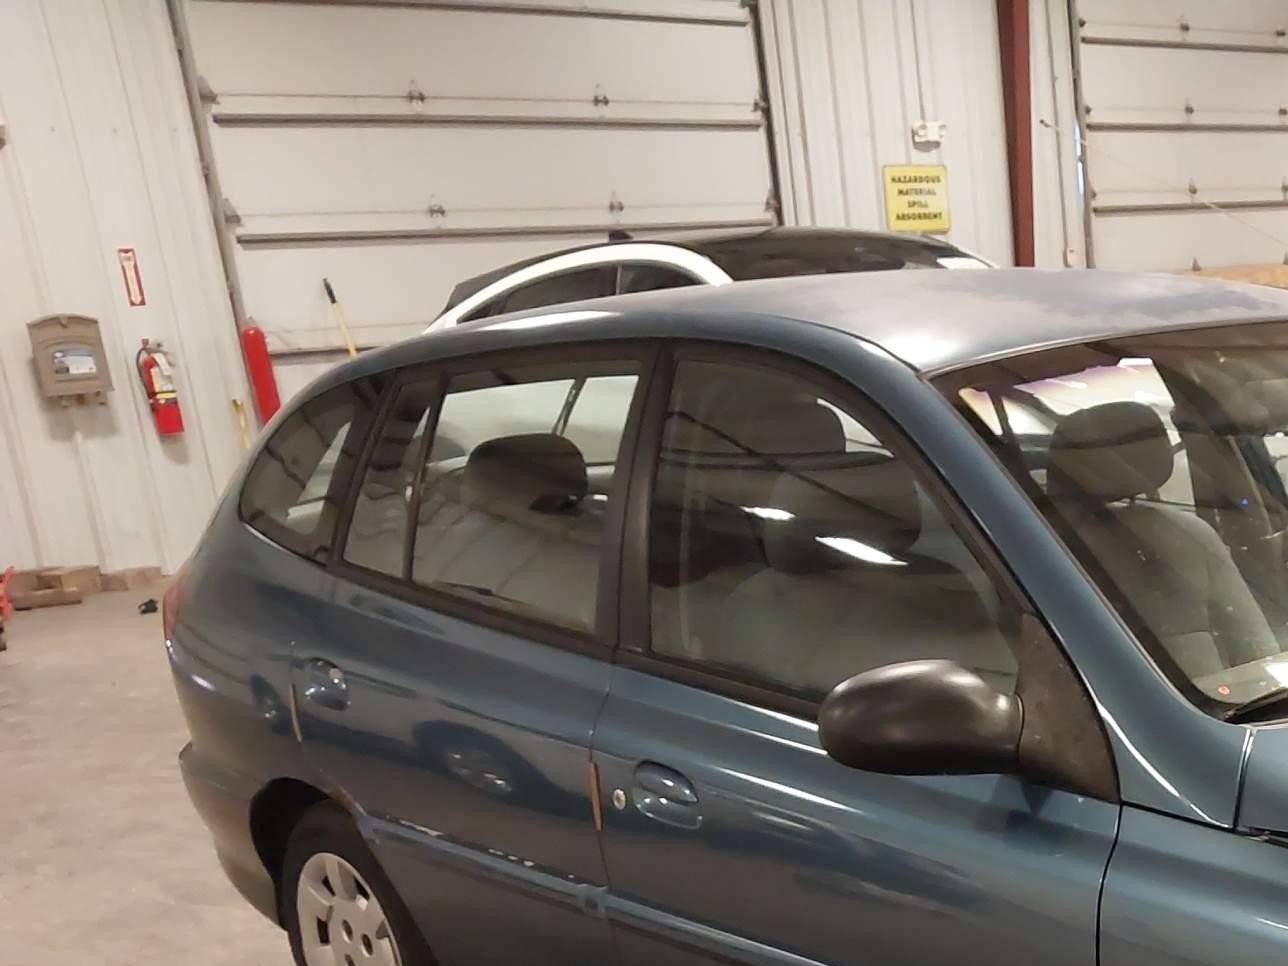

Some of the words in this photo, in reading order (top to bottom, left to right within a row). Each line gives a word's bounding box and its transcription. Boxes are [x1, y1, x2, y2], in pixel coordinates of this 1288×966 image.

[891, 175, 941, 184] HAZARDOUS
[897, 188, 936, 196] MATERIAL
[907, 200, 929, 208] SPILL
[896, 212, 942, 221] ABSORBENT
